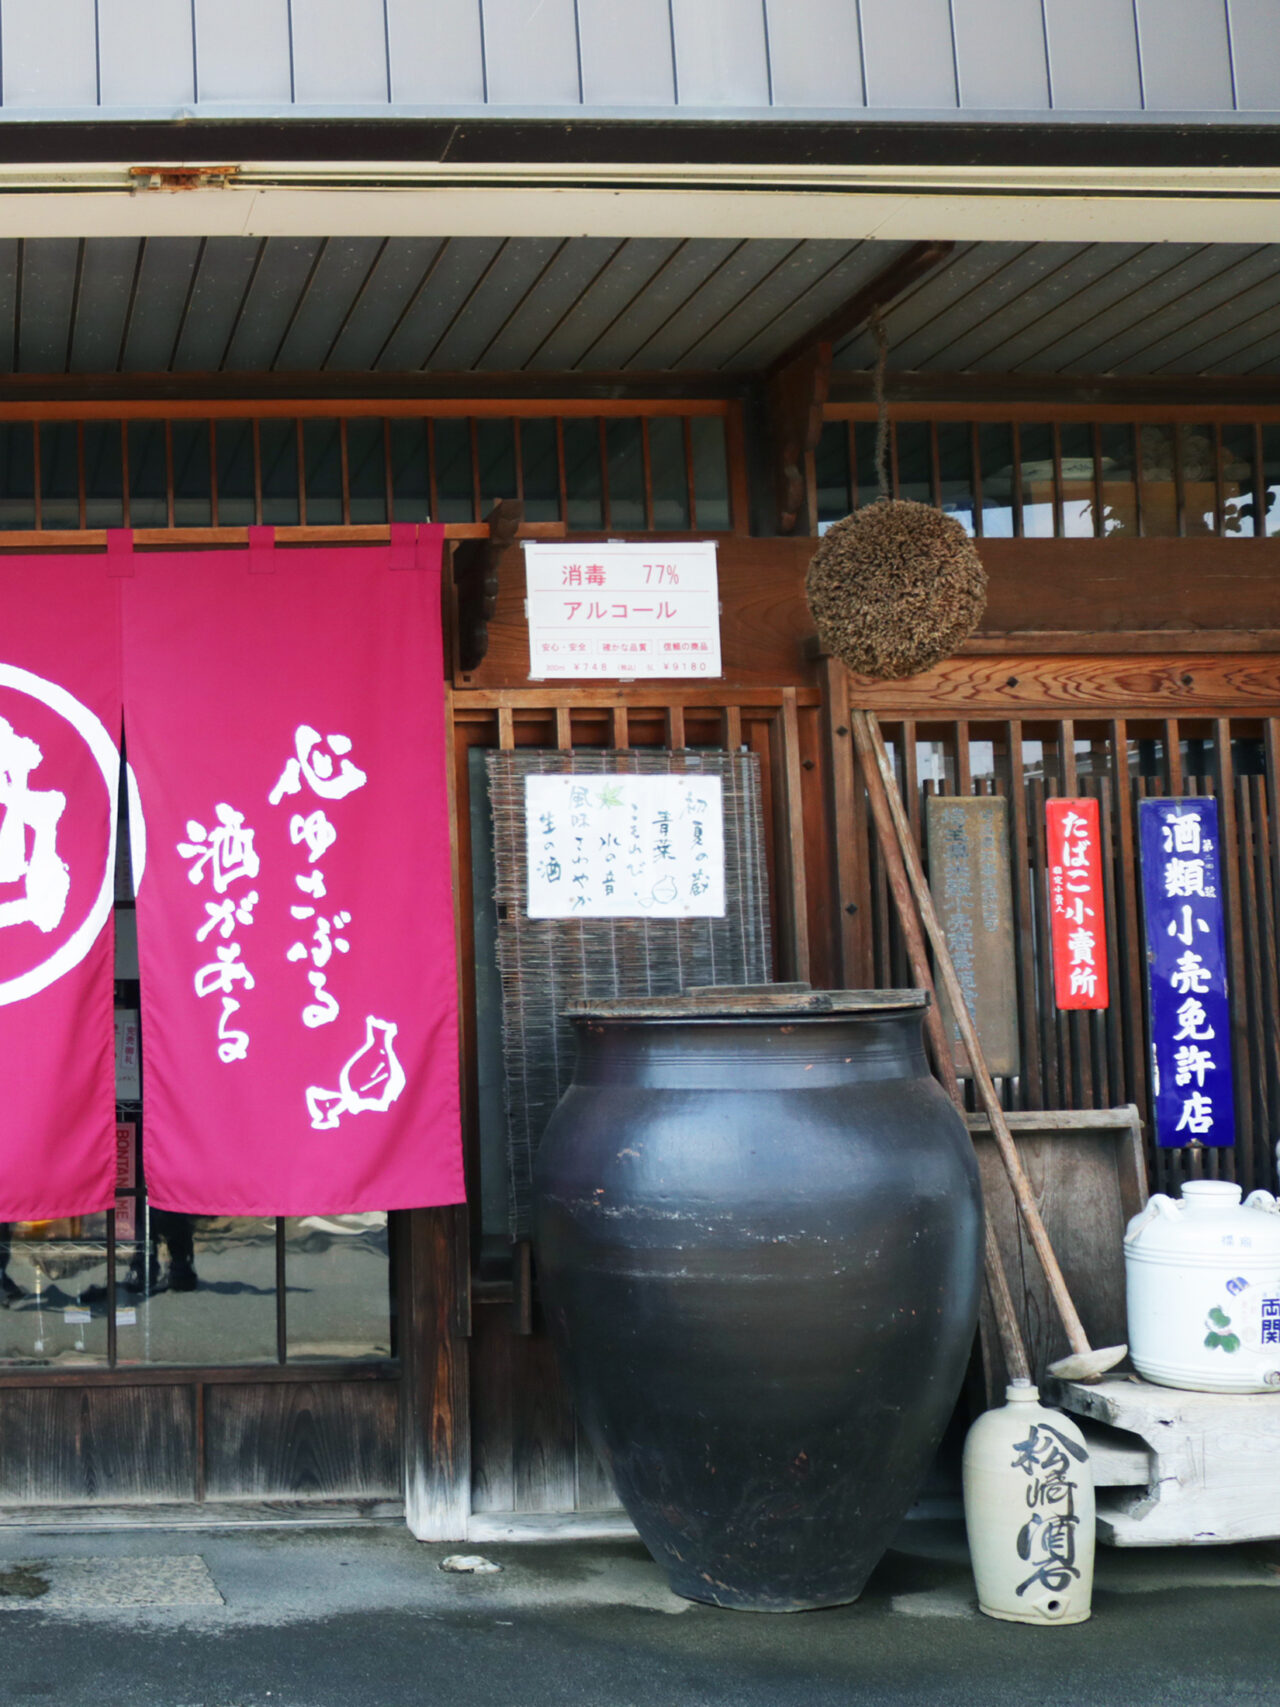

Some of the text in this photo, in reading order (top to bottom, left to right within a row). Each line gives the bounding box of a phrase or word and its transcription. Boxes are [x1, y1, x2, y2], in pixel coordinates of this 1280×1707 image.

[562, 563, 680, 586] 消毒 77%
[563, 601, 677, 620] アルコール
[176, 802, 260, 1064] 酒がある
[268, 724, 368, 1029] 心ゆさぶる
[1061, 811, 1098, 998] たばこ小賣所
[1162, 812, 1216, 1135] 酒類小売免許店
